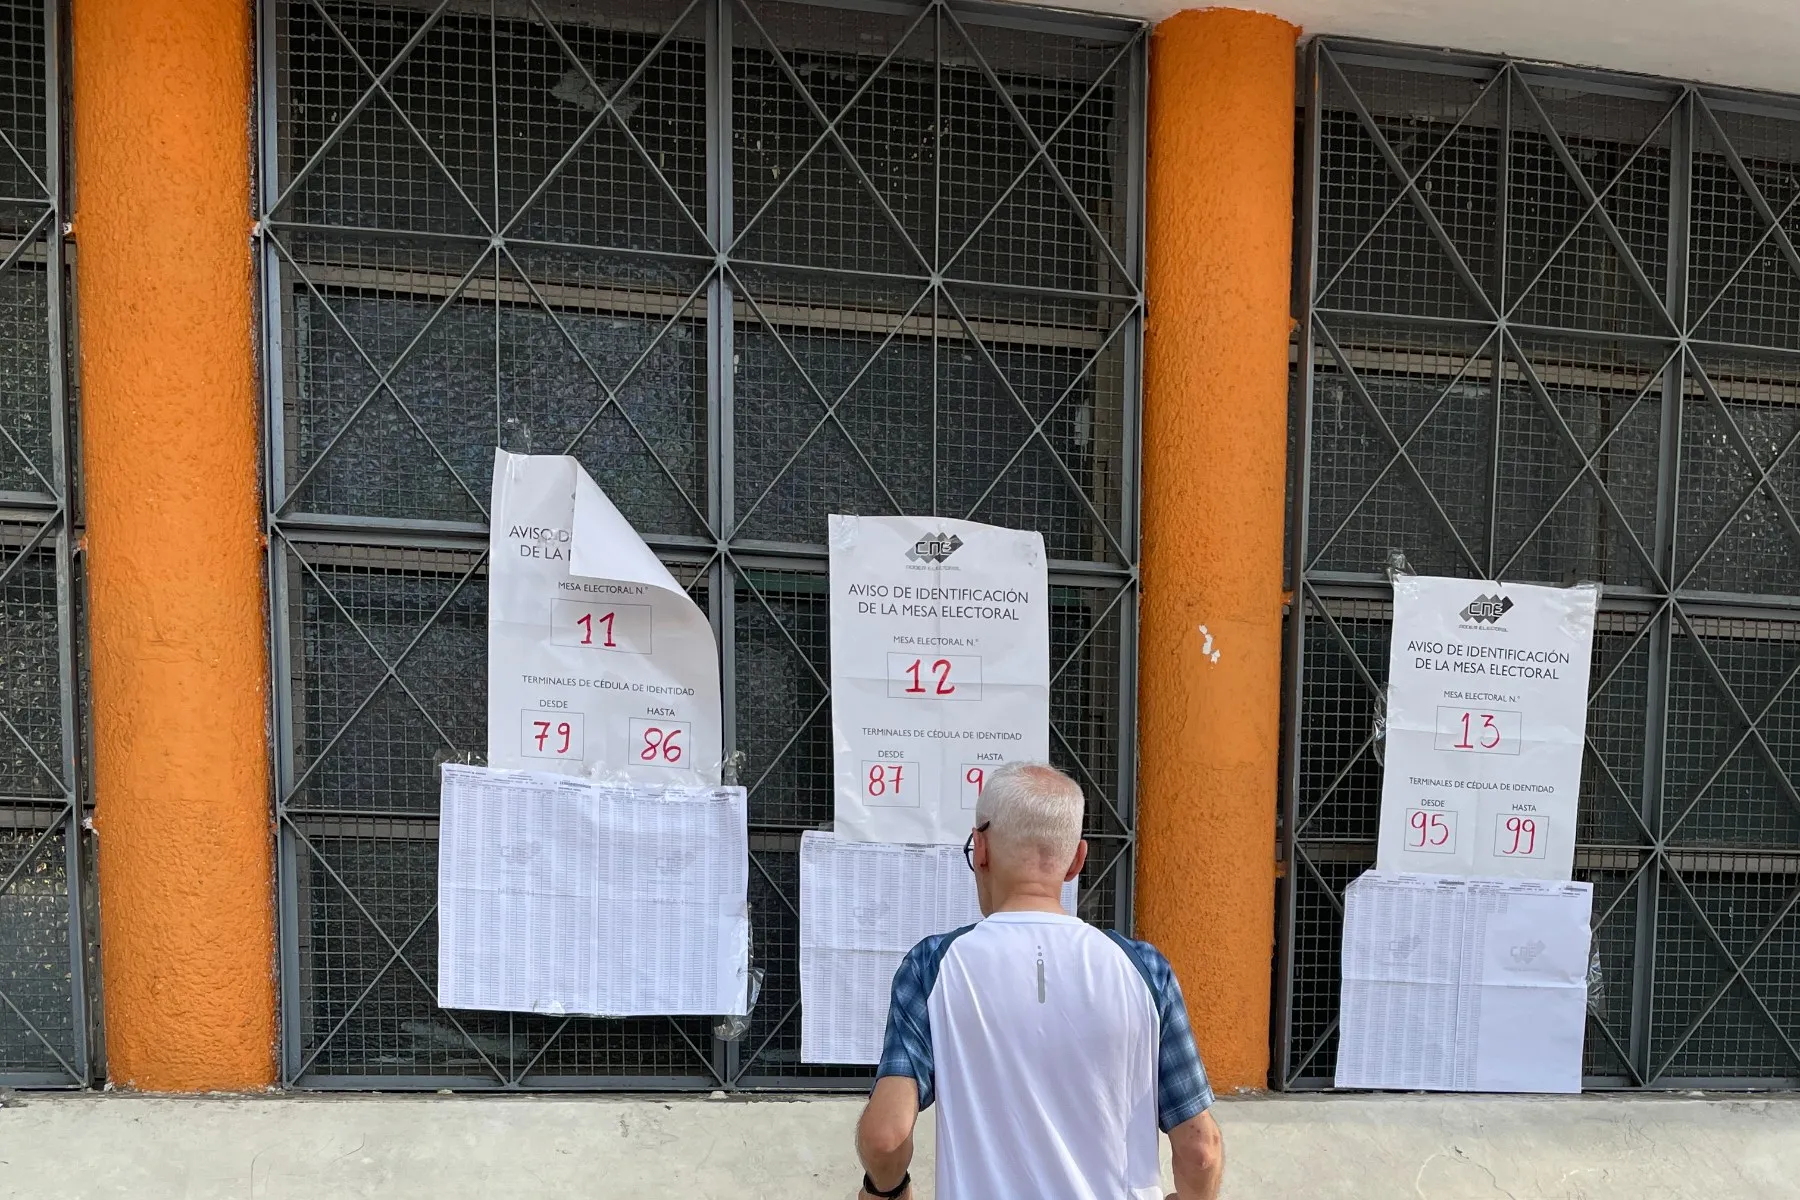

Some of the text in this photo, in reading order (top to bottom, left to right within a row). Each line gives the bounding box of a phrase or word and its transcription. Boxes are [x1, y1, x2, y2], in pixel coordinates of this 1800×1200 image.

[508, 525, 573, 543] AVISO D
[520, 544, 540, 559] DE
[544, 547, 564, 561] LA
[558, 582, 581, 592] MESA
[584, 584, 635, 594] ELECTORAL
[848, 584, 1029, 604] AVISO DE IDENTIFICACIÓN
[858, 601, 1020, 621] DE LA MESA ELECTORAL
[577, 612, 616, 647] 11
[893, 635, 915, 645] MESA
[917, 637, 964, 647] ELECTORAL
[1407, 640, 1570, 664] AVISO DE IDENTIFICACIÓN
[905, 658, 956, 695] 12
[1415, 657, 1560, 680] DE LA MESA ELECTORAL
[521, 674, 695, 697] TERMINALES DE CÉDULA DE IDENTIDAD
[539, 699, 569, 709] DESDE
[1443, 690, 1463, 700] MESA
[1465, 692, 1507, 703] ELECTORAL
[646, 707, 676, 717] HASTA
[533, 720, 571, 754] 79
[861, 727, 1023, 742] TERMINALES DE CÉDULA DE IDENTIDAD
[1453, 712, 1501, 749] 13
[640, 727, 682, 763] 86
[878, 750, 905, 759] DESDE
[976, 752, 1004, 762] HASTA
[868, 764, 905, 797] 87
[966, 767, 985, 797] 9
[1408, 776, 1555, 794] TERMINALES DE CÉDULA DE IDENTIDAD
[1420, 798, 1446, 808] DESDE
[1511, 803, 1538, 813] HASTA
[1409, 810, 1449, 847] 95
[1502, 816, 1536, 855] 99
